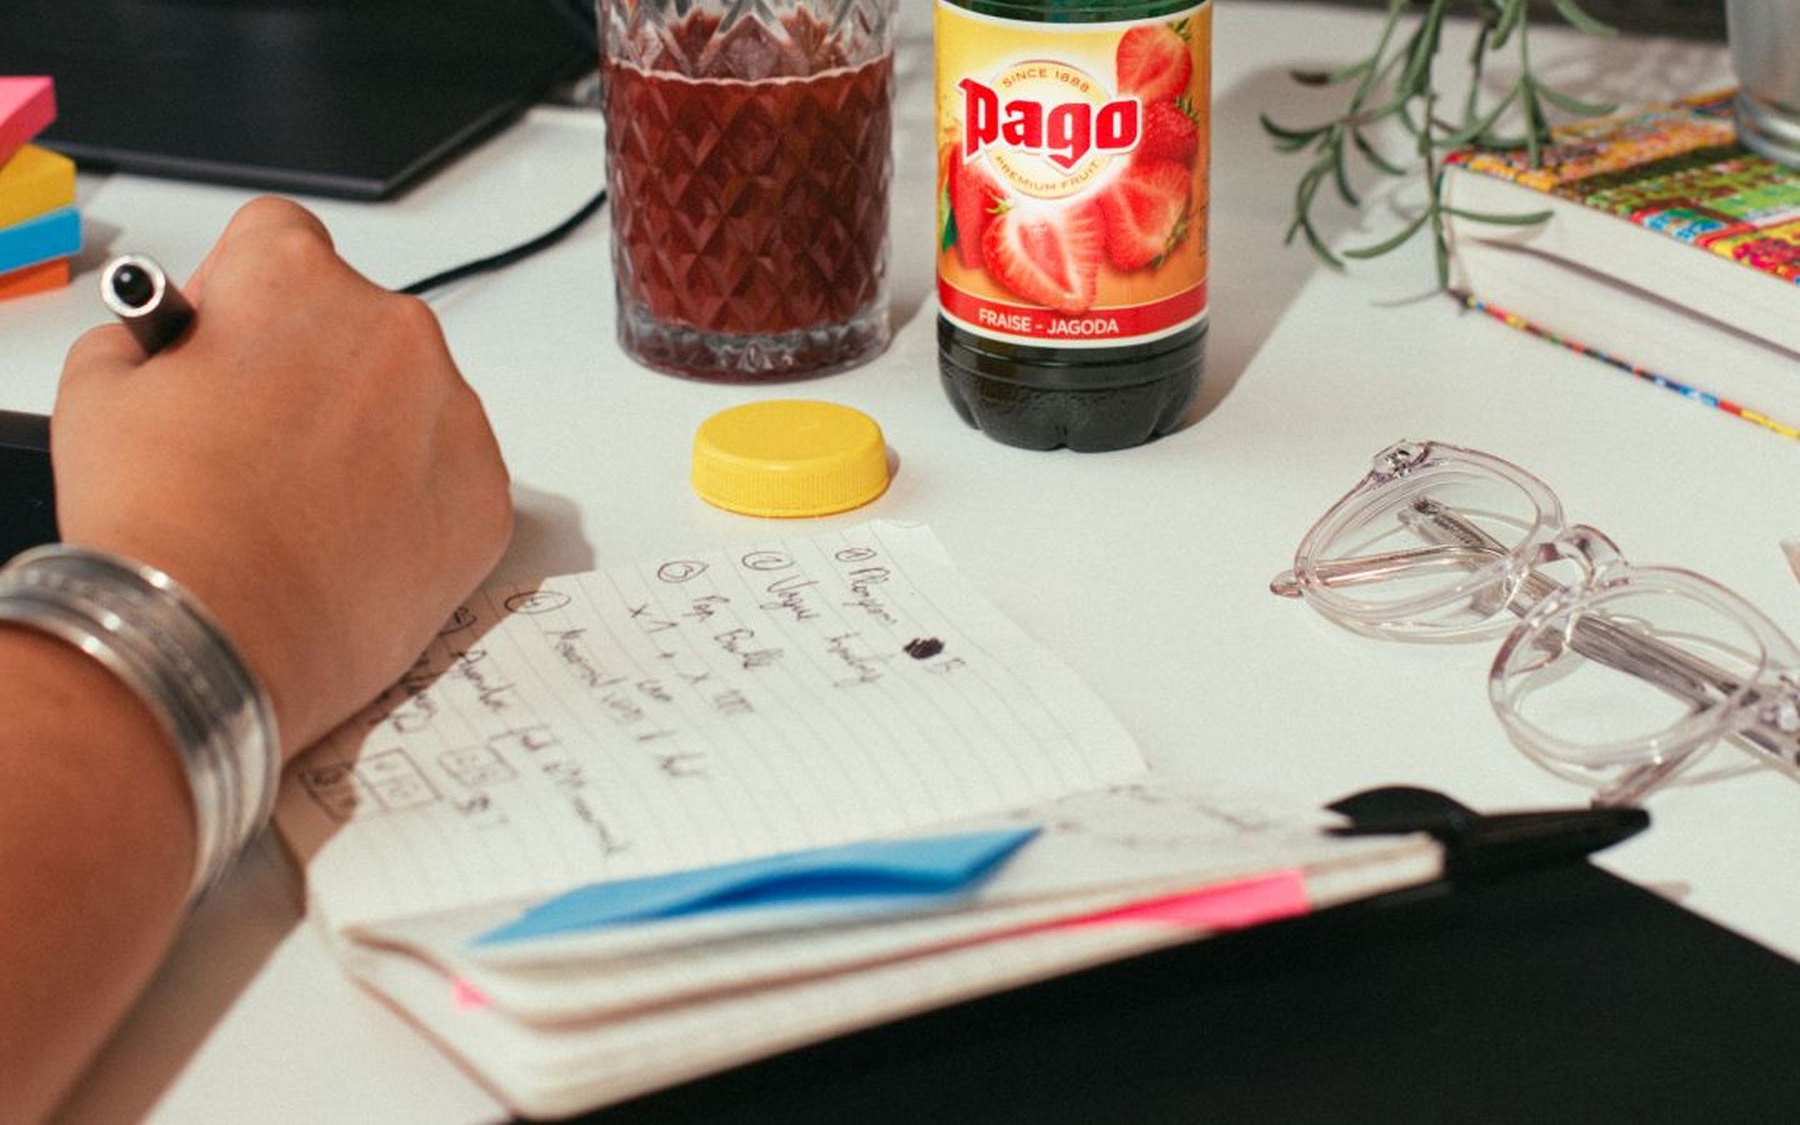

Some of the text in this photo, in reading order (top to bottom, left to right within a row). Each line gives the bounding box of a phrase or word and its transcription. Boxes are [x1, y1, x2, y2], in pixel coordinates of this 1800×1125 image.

[1002, 67, 1090, 94] SINCE 1888
[995, 155, 1100, 192] PREMIUM FRUIT
[979, 307, 1032, 332] FRAISE
[1046, 317, 1119, 336] JAGODA
